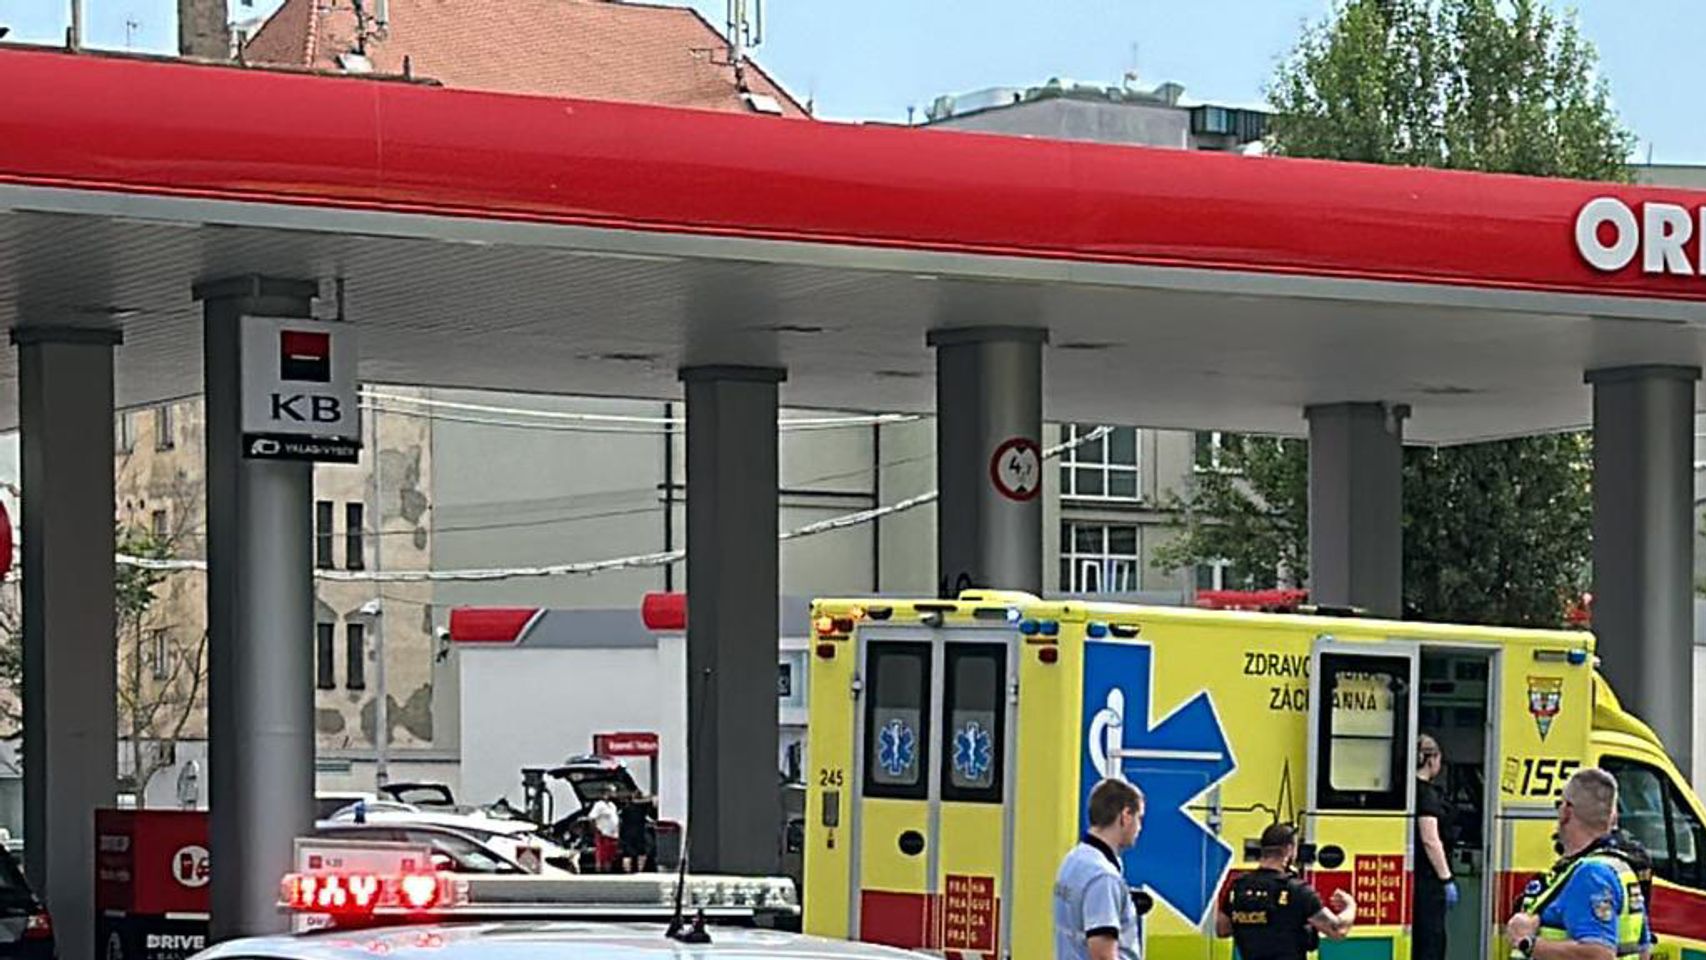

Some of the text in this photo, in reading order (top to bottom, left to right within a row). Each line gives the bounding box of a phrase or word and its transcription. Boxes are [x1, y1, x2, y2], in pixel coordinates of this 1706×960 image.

[271, 393, 341, 422] KB
[820, 768, 843, 787] 245
[1521, 758, 1580, 795] 155
[146, 934, 205, 949] DRIVE
